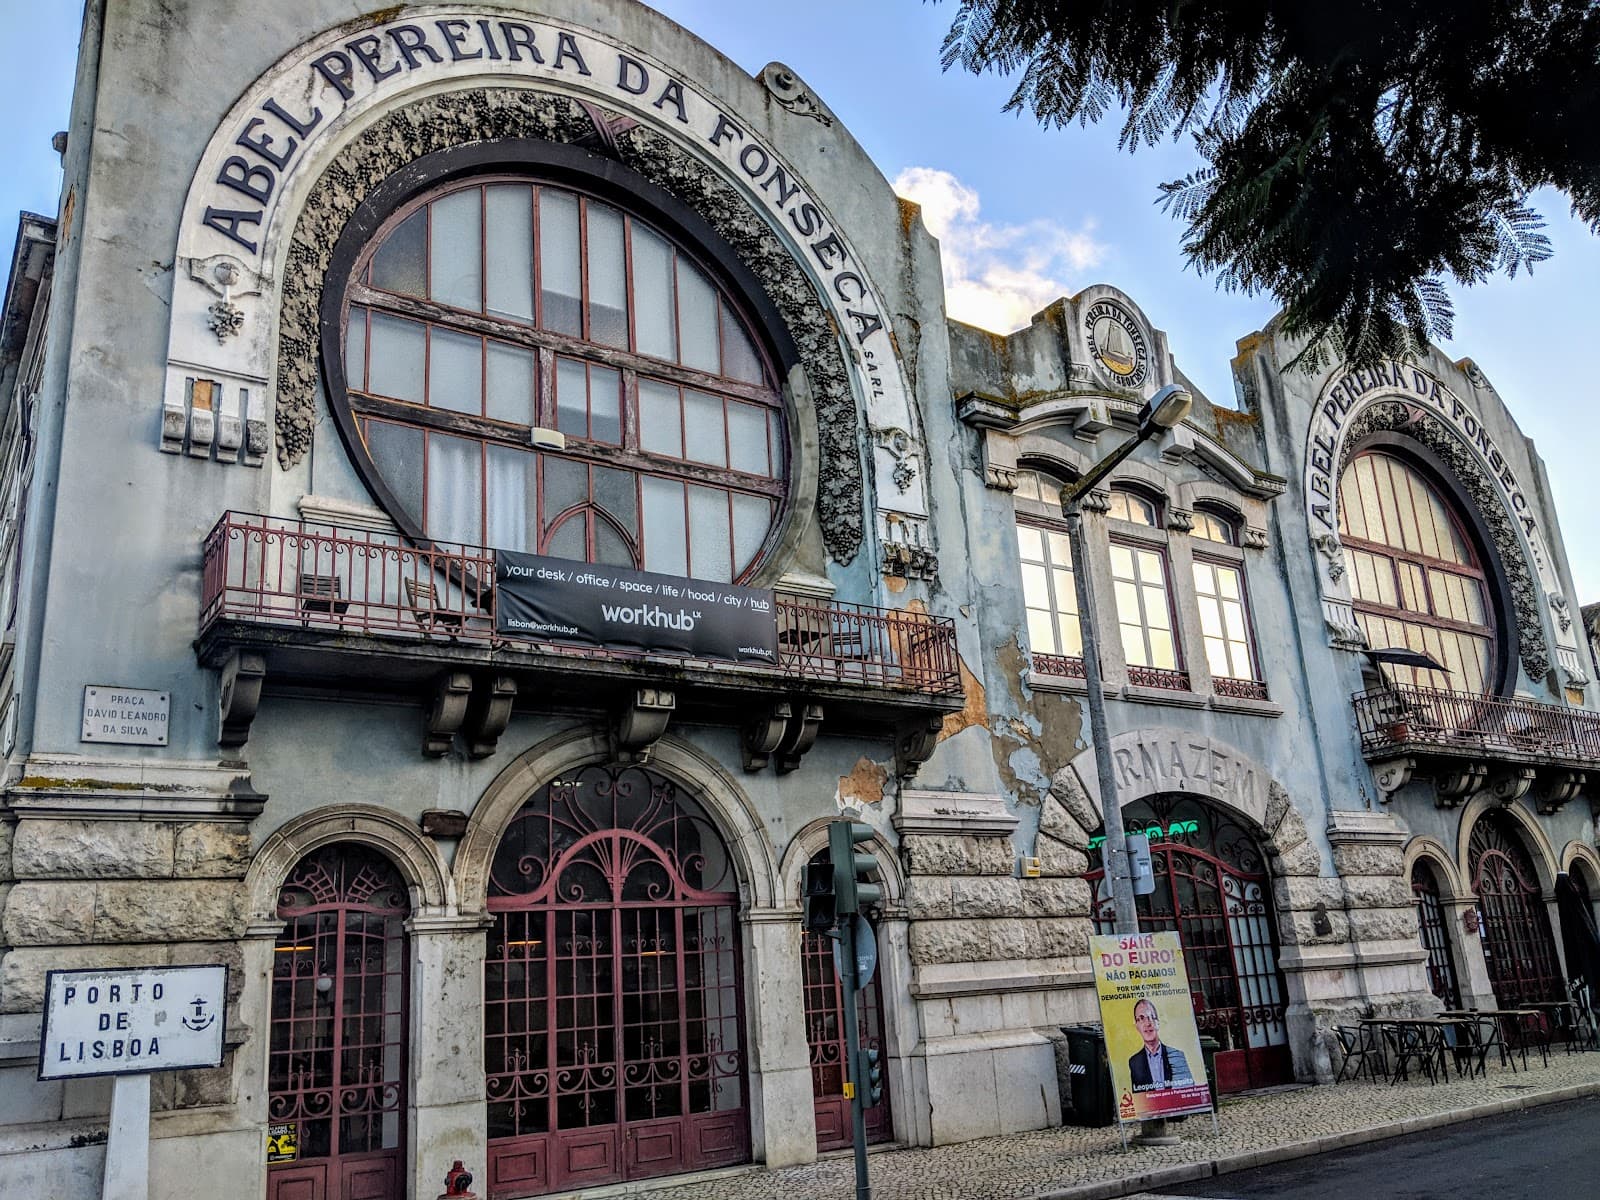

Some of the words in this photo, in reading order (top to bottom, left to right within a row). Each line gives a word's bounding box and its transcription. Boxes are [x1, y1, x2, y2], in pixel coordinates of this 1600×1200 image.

[203, 97, 323, 255] ABEL
[310, 19, 592, 101] PEREIRA
[617, 54, 690, 124] DA
[709, 113, 883, 345] FONSECA
[1085, 304, 1110, 330] PEREIRA
[1112, 308, 1122, 321] DA
[1122, 315, 1146, 360] FONSECA
[1312, 435, 1336, 530] ABEL
[1324, 361, 1409, 430] PEREIRA
[1413, 370, 1446, 409] DA
[1453, 401, 1537, 537] FONSECA
[506, 564, 534, 578] your
[537, 568, 566, 581] desk
[568, 571, 573, 582] /
[576, 573, 610, 588] office
[612, 578, 617, 588] /
[620, 581, 653, 596] space
[655, 584, 660, 595] /
[662, 585, 679, 598] life
[681, 588, 687, 599] /
[688, 588, 716, 602] hood
[717, 593, 722, 603] /
[724, 594, 742, 608] city
[744, 596, 749, 607] /
[751, 597, 770, 611] hub
[507, 618, 578, 635] lisbon@workhub.pt
[601, 604, 695, 631] workhub
[738, 646, 773, 657] workhub.pt
[111, 695, 145, 706] PRAÇA
[87, 708, 118, 719] DAVID
[121, 710, 167, 722] LEANDRO
[102, 725, 116, 734] DA
[121, 725, 149, 735] SILVA
[1114, 741, 1257, 807] RMAZEM
[1119, 934, 1154, 949] SAIR
[1102, 953, 1123, 967] DO
[1128, 949, 1176, 964] EURO!
[1106, 969, 1126, 981] NÃO
[1129, 968, 1177, 980] PAGAMOS!
[64, 983, 163, 1006] PORTO
[1142, 982, 1171, 990] GOVERNO
[98, 1012, 129, 1031] DE
[59, 1037, 160, 1062] LISBOA
[1133, 1081, 1164, 1091] Leopoldo
